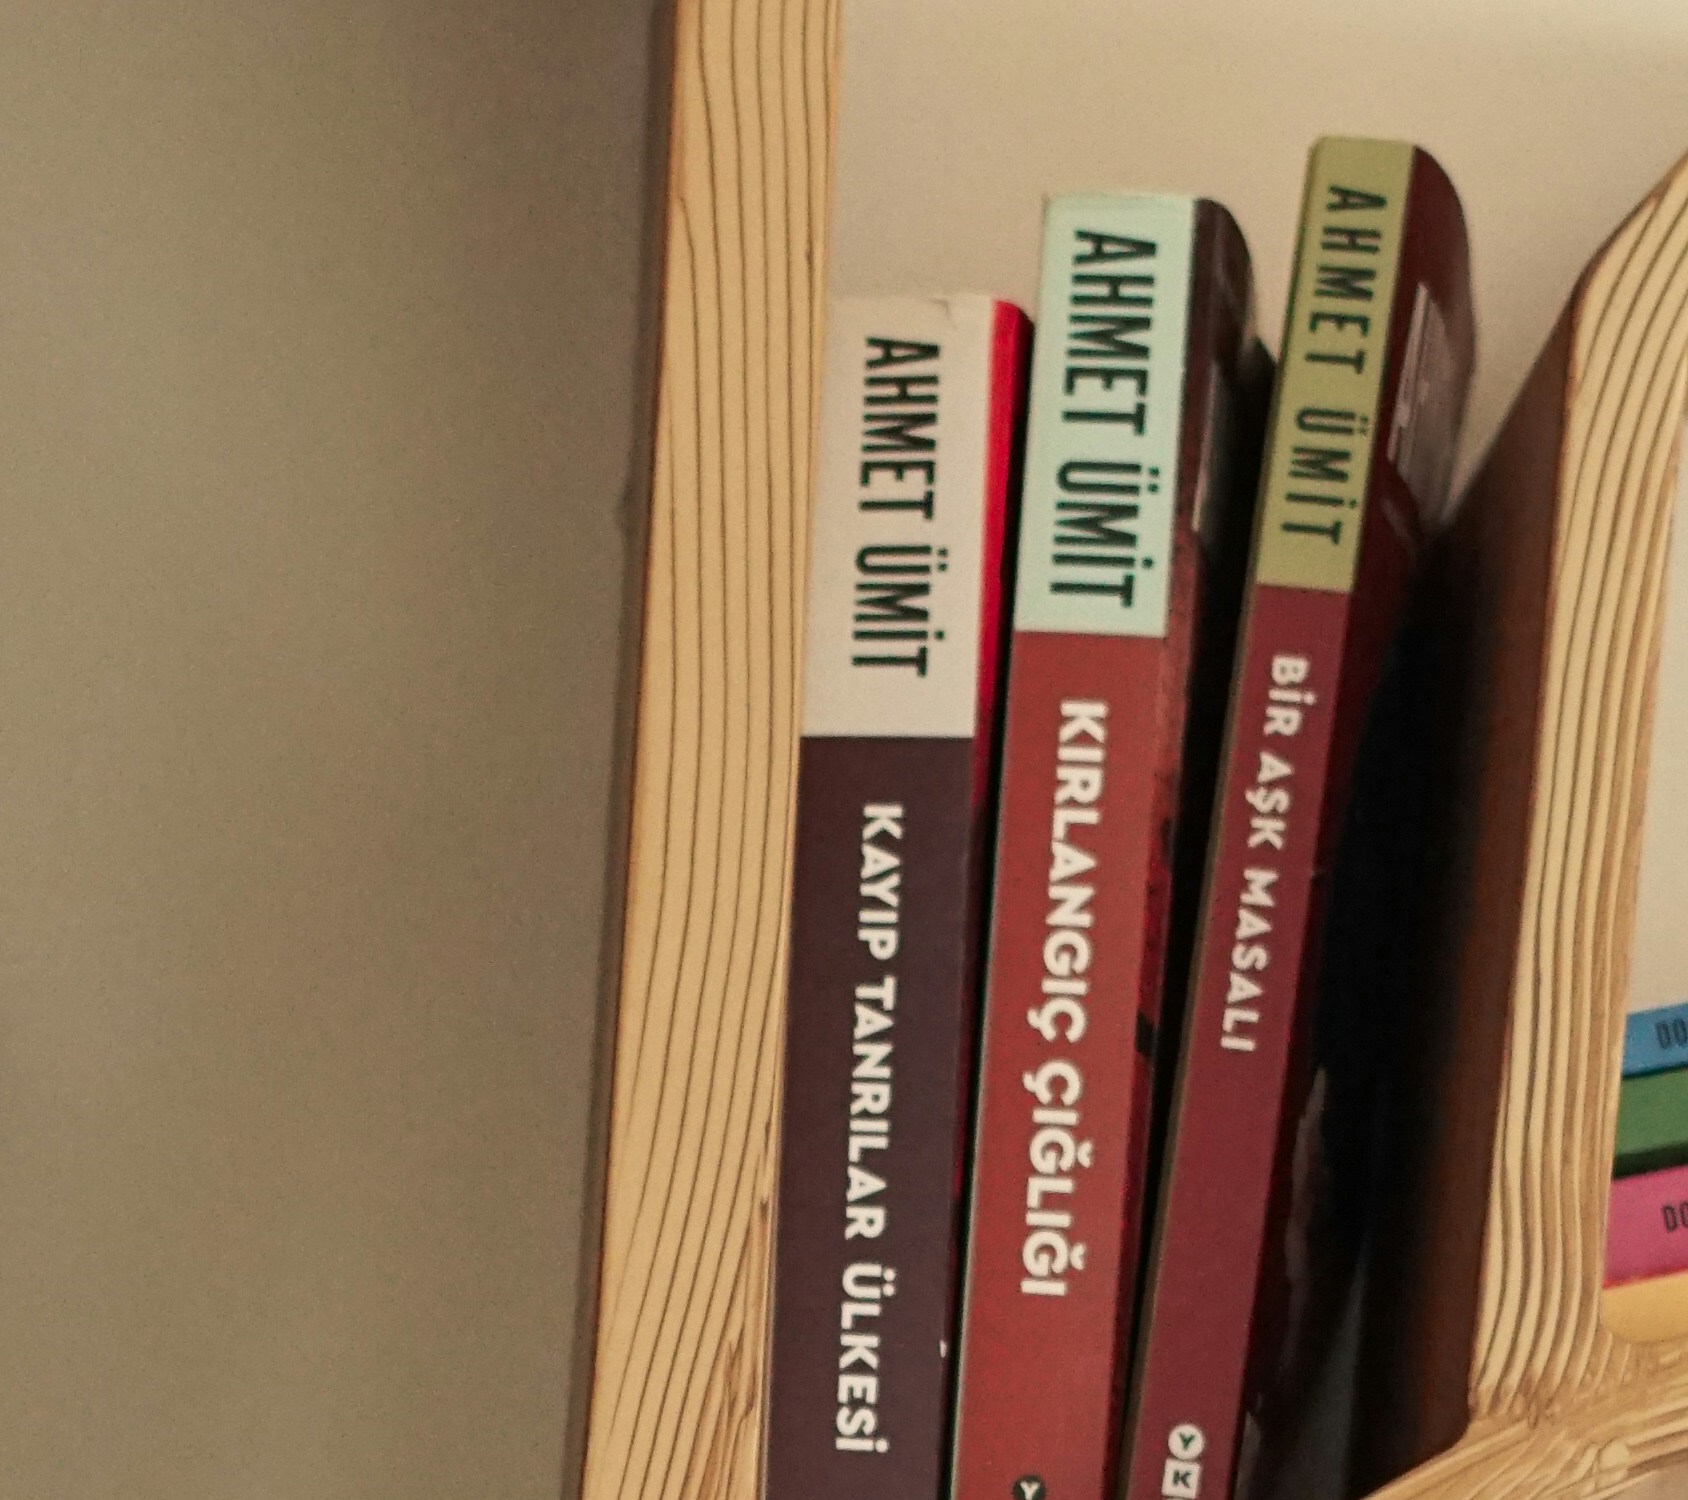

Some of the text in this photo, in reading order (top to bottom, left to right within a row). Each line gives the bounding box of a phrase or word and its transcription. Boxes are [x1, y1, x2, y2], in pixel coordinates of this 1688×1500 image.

[851, 336, 950, 679] AHMET ÜMİT
[1049, 229, 1161, 610] AHMET ÜMİT
[1279, 183, 1389, 547] AHMET ÜMİT
[1020, 699, 1109, 1297] KIRLANGIÇ ÇIĞLIĞI
[1220, 654, 1317, 1054] BİR AŞK MASALI
[834, 802, 903, 1455] KAYIP TANRILAR ÜLKESİ
